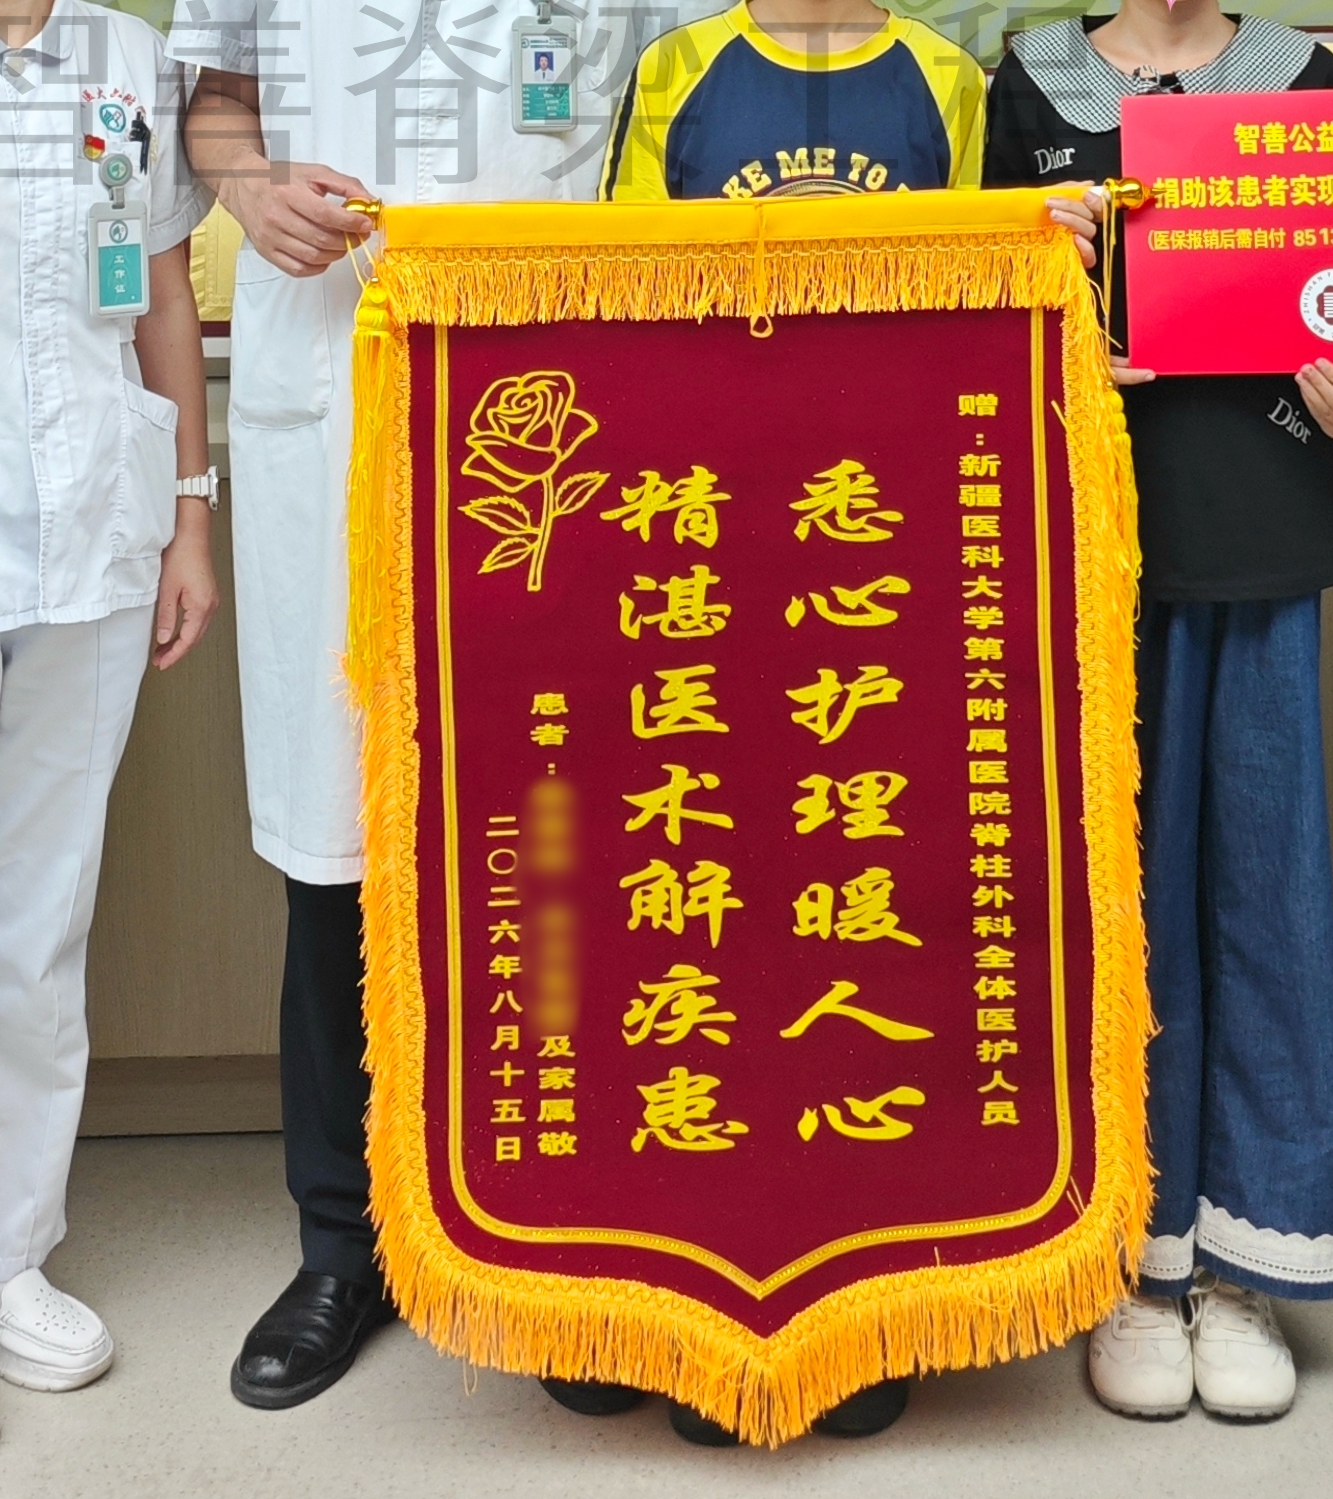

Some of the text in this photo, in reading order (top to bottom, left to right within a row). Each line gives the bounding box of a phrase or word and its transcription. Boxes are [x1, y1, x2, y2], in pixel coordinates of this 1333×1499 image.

[776, 147, 836, 180] ME
[848, 152, 889, 190] TO
[1033, 146, 1076, 175] Dior
[1267, 397, 1312, 445] Dior
[600, 465, 749, 1153] 精湛医术解疾患
[779, 459, 936, 1142] 悉心护理暖人心
